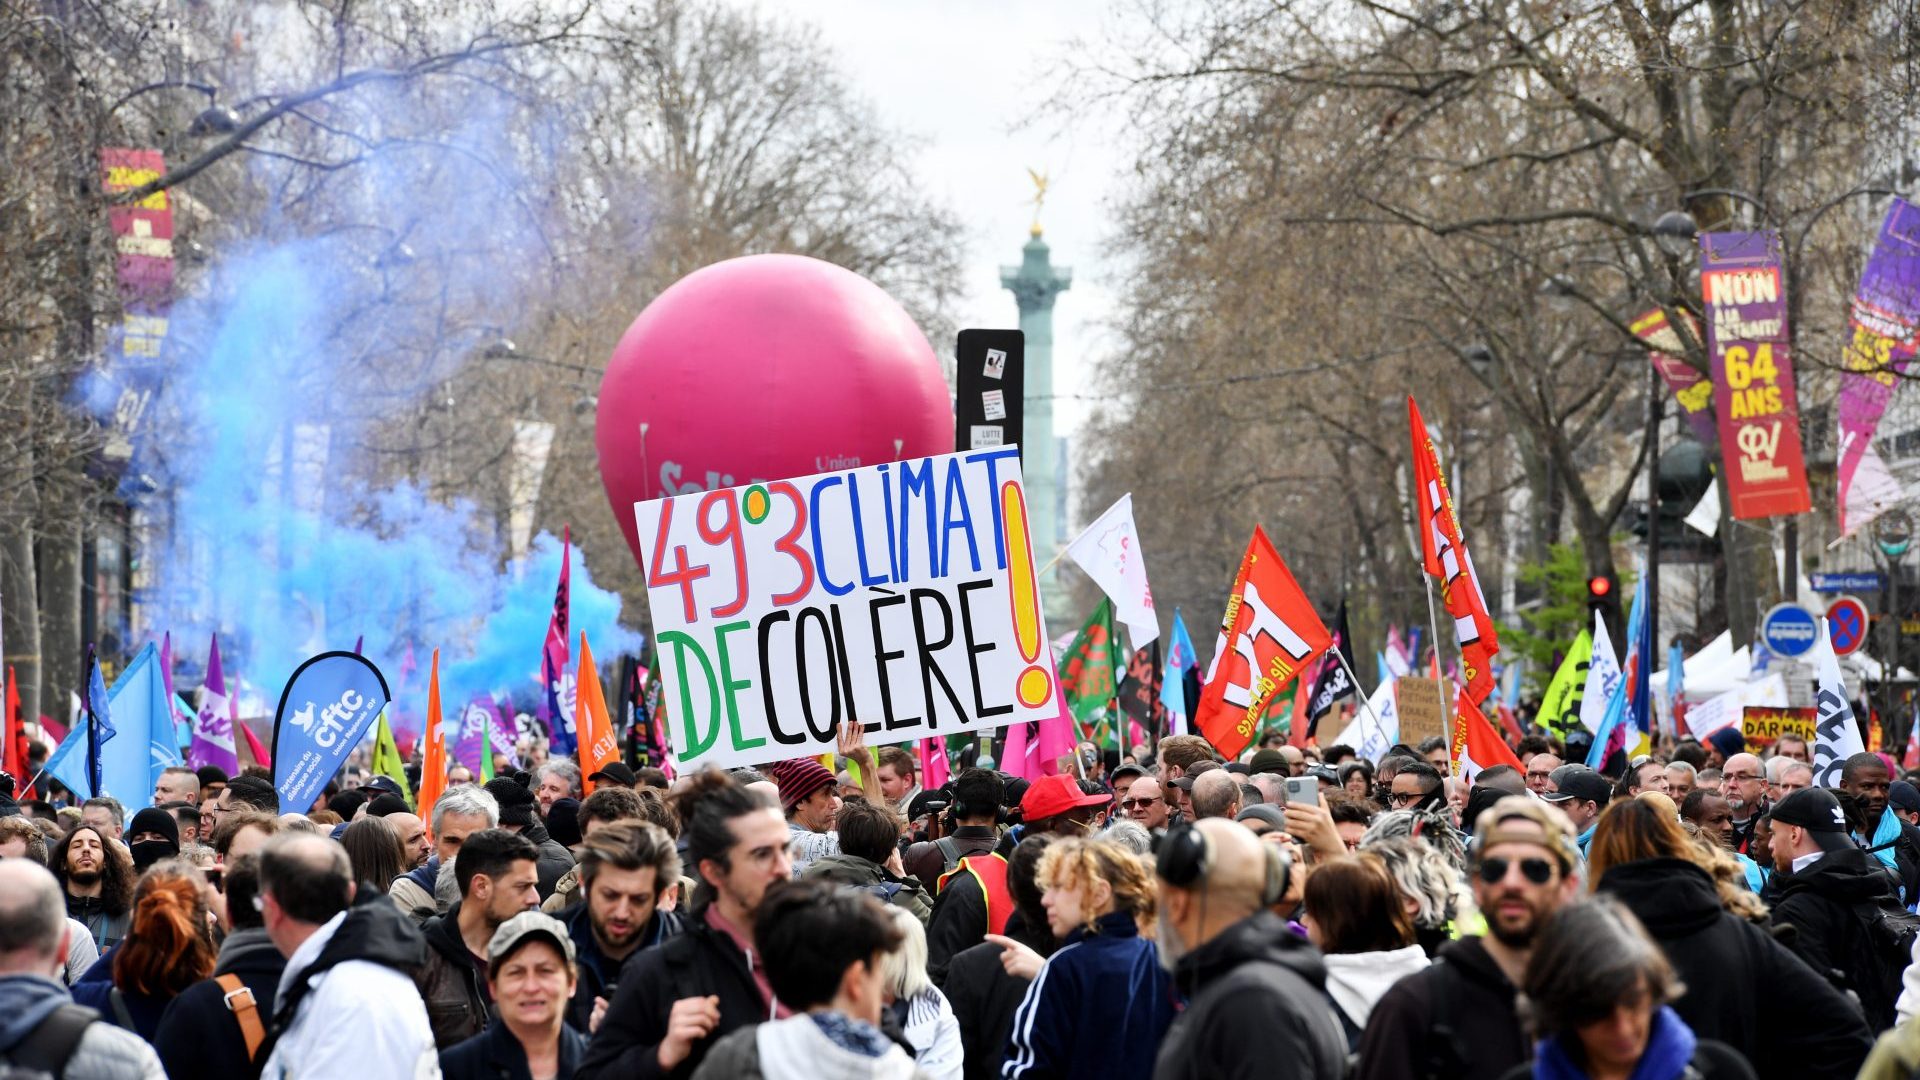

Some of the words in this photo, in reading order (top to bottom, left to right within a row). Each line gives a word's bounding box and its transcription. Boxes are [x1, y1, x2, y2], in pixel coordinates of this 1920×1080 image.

[1710, 273, 1777, 306] NON
[1725, 342, 1778, 390] 64
[1731, 386, 1783, 420] ANS
[982, 429, 1001, 439] LUTTE
[815, 455, 861, 472] Union
[656, 620, 767, 763] DE
[315, 689, 364, 748] cftc
[332, 738, 348, 757] Union
[279, 759, 306, 795] Partenaire
[303, 750, 312, 762] du
[287, 769, 309, 802] dialogue
[306, 753, 323, 778] social
